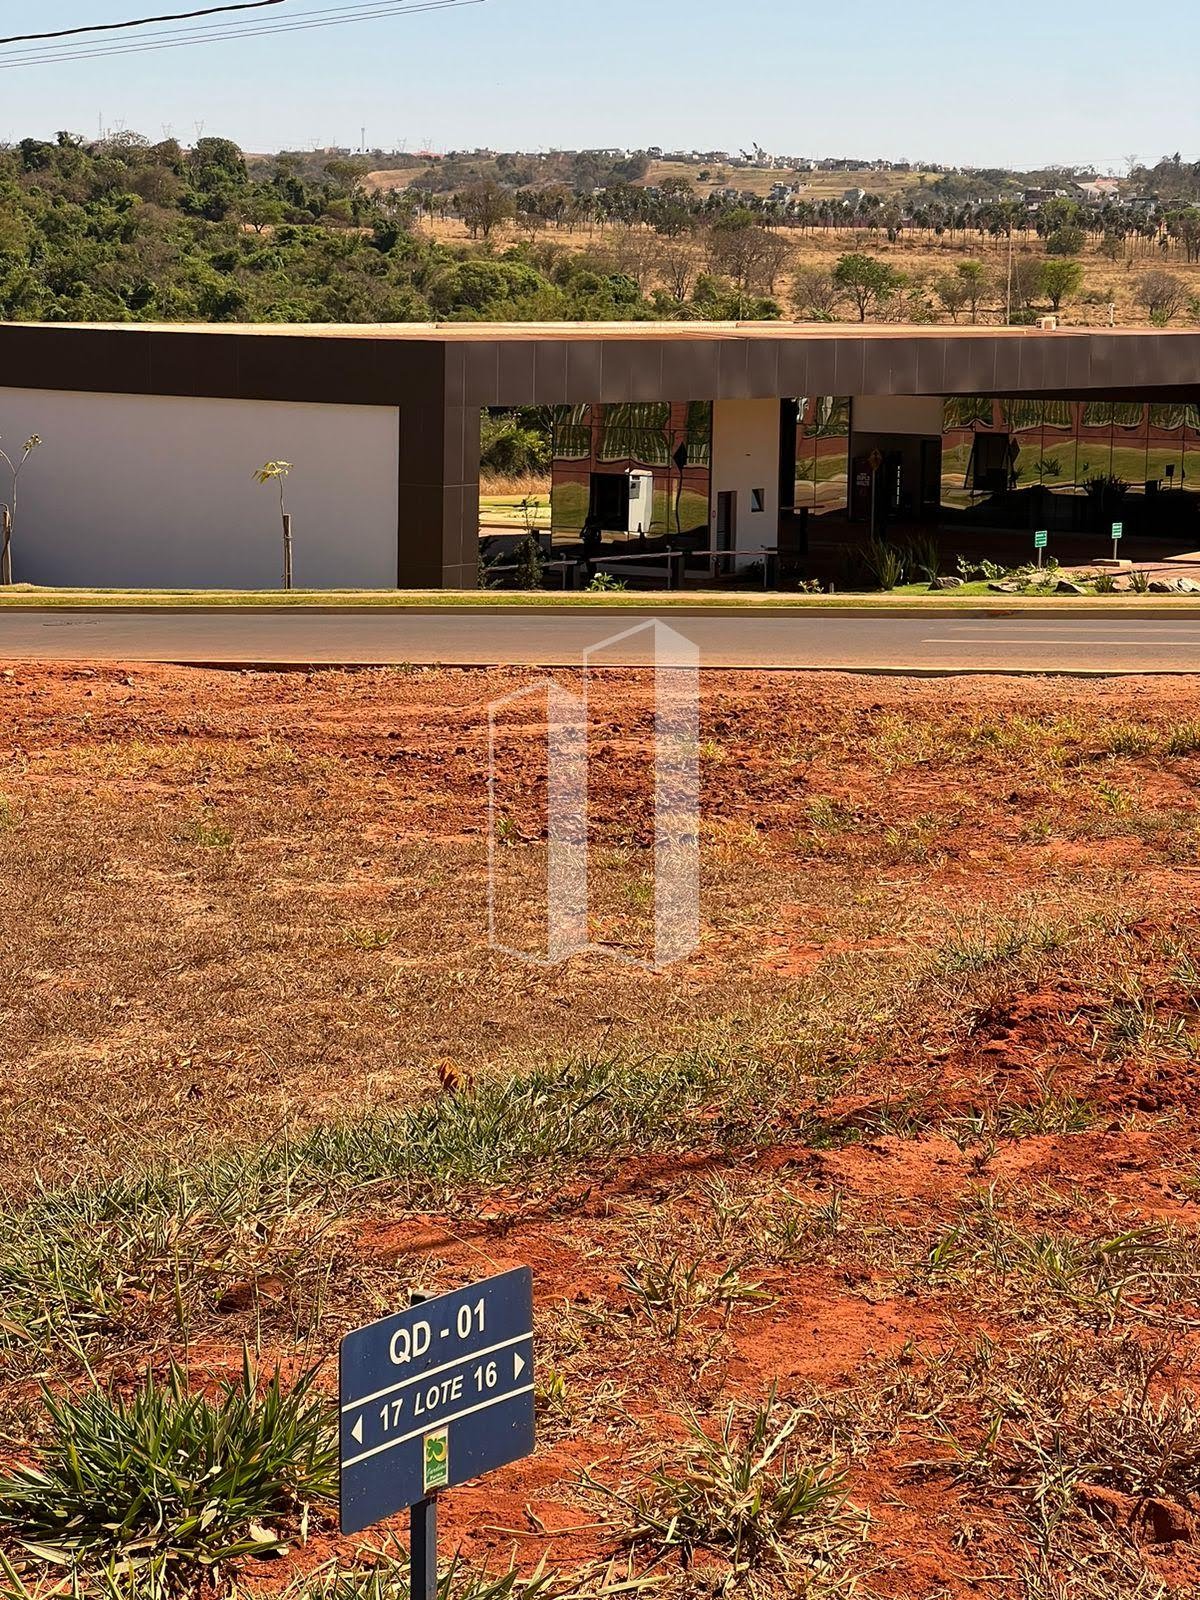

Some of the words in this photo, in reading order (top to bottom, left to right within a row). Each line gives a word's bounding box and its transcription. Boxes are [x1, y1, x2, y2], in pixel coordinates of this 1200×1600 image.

[389, 1320, 431, 1365] QD
[440, 1328, 449, 1338] -
[457, 1298, 486, 1339] 01
[379, 1399, 404, 1431] 17
[414, 1374, 464, 1416] LOTE
[473, 1361, 498, 1392] 16
